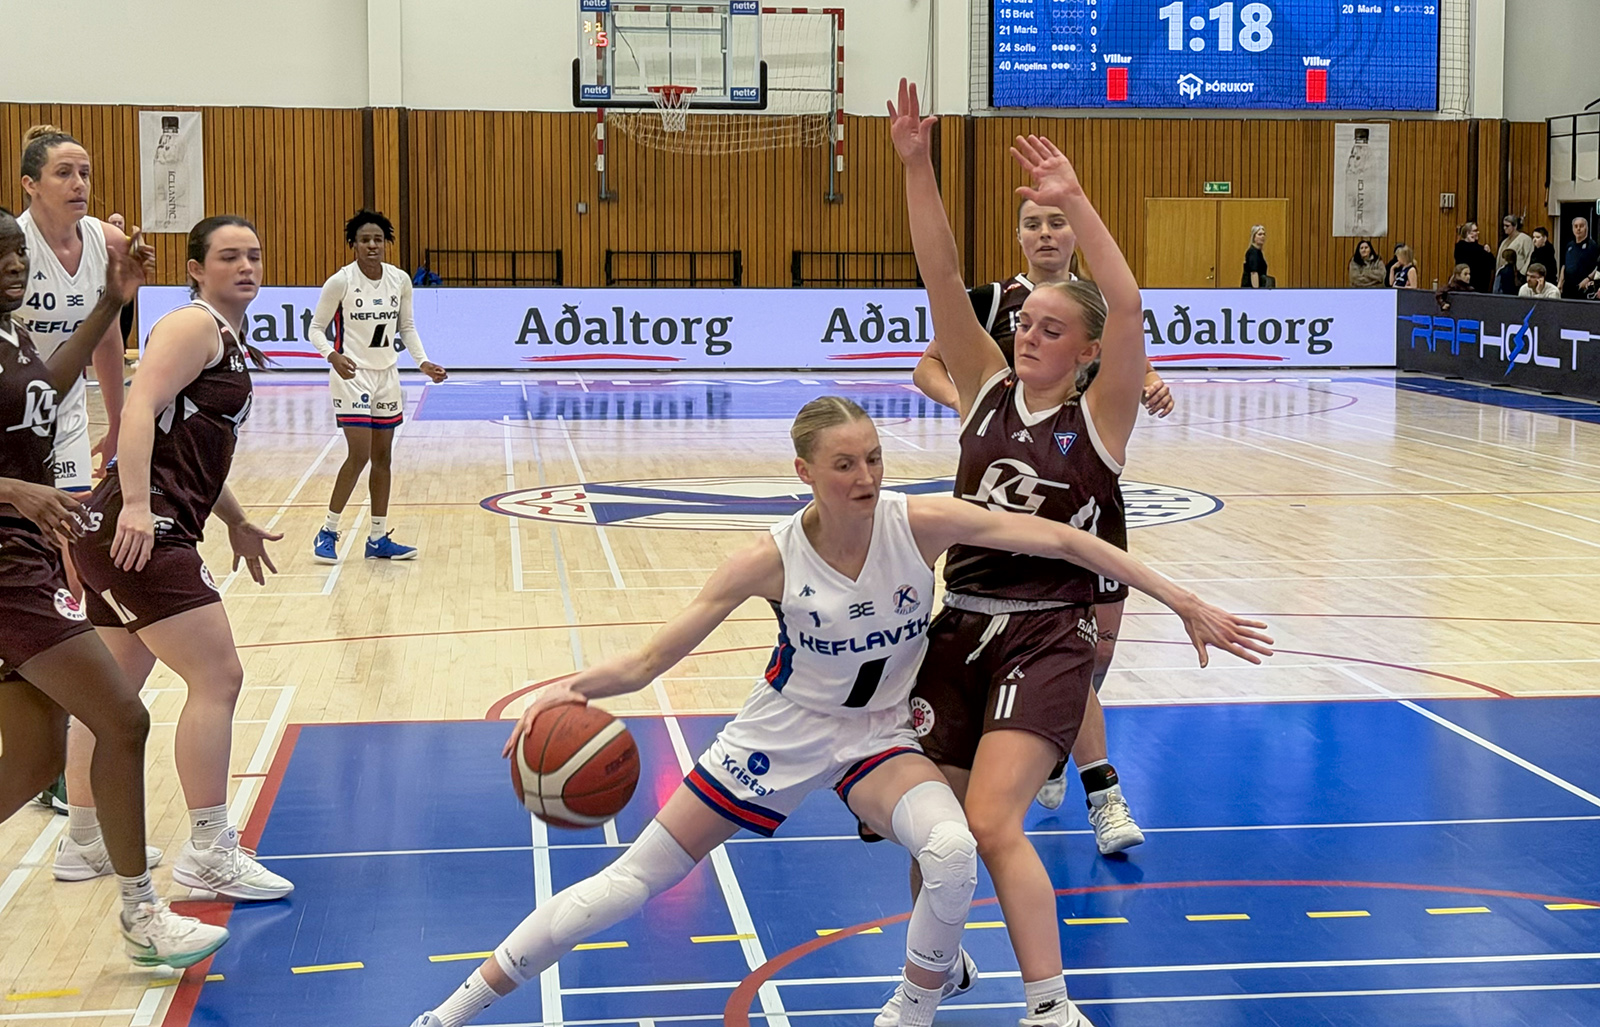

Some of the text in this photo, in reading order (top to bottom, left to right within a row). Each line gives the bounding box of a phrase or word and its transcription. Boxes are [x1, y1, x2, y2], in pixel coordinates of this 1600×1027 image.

[999, 9, 1011, 18] 15
[1342, 4, 1354, 14] 20
[1423, 6, 1435, 15] 32
[999, 25, 1010, 35] 21
[1159, 1, 1273, 52] 1:18
[999, 43, 1011, 52] 24
[1090, 43, 1097, 53] 3
[1103, 54, 1132, 63] Villur
[1302, 56, 1331, 66] Villur
[999, 61, 1097, 72] 40 Angelina 3
[1205, 80, 1254, 93] ÞÓRUKOT
[26, 292, 56, 310] 40
[355, 298, 363, 308] 0
[350, 310, 399, 320] KEFLAVÍ
[515, 303, 733, 356] Aðaltorg
[1142, 304, 1334, 355] Aðaltorg
[808, 611, 821, 628] 1
[799, 611, 929, 656] KEFLAVÍK
[993, 684, 1018, 720] 11
